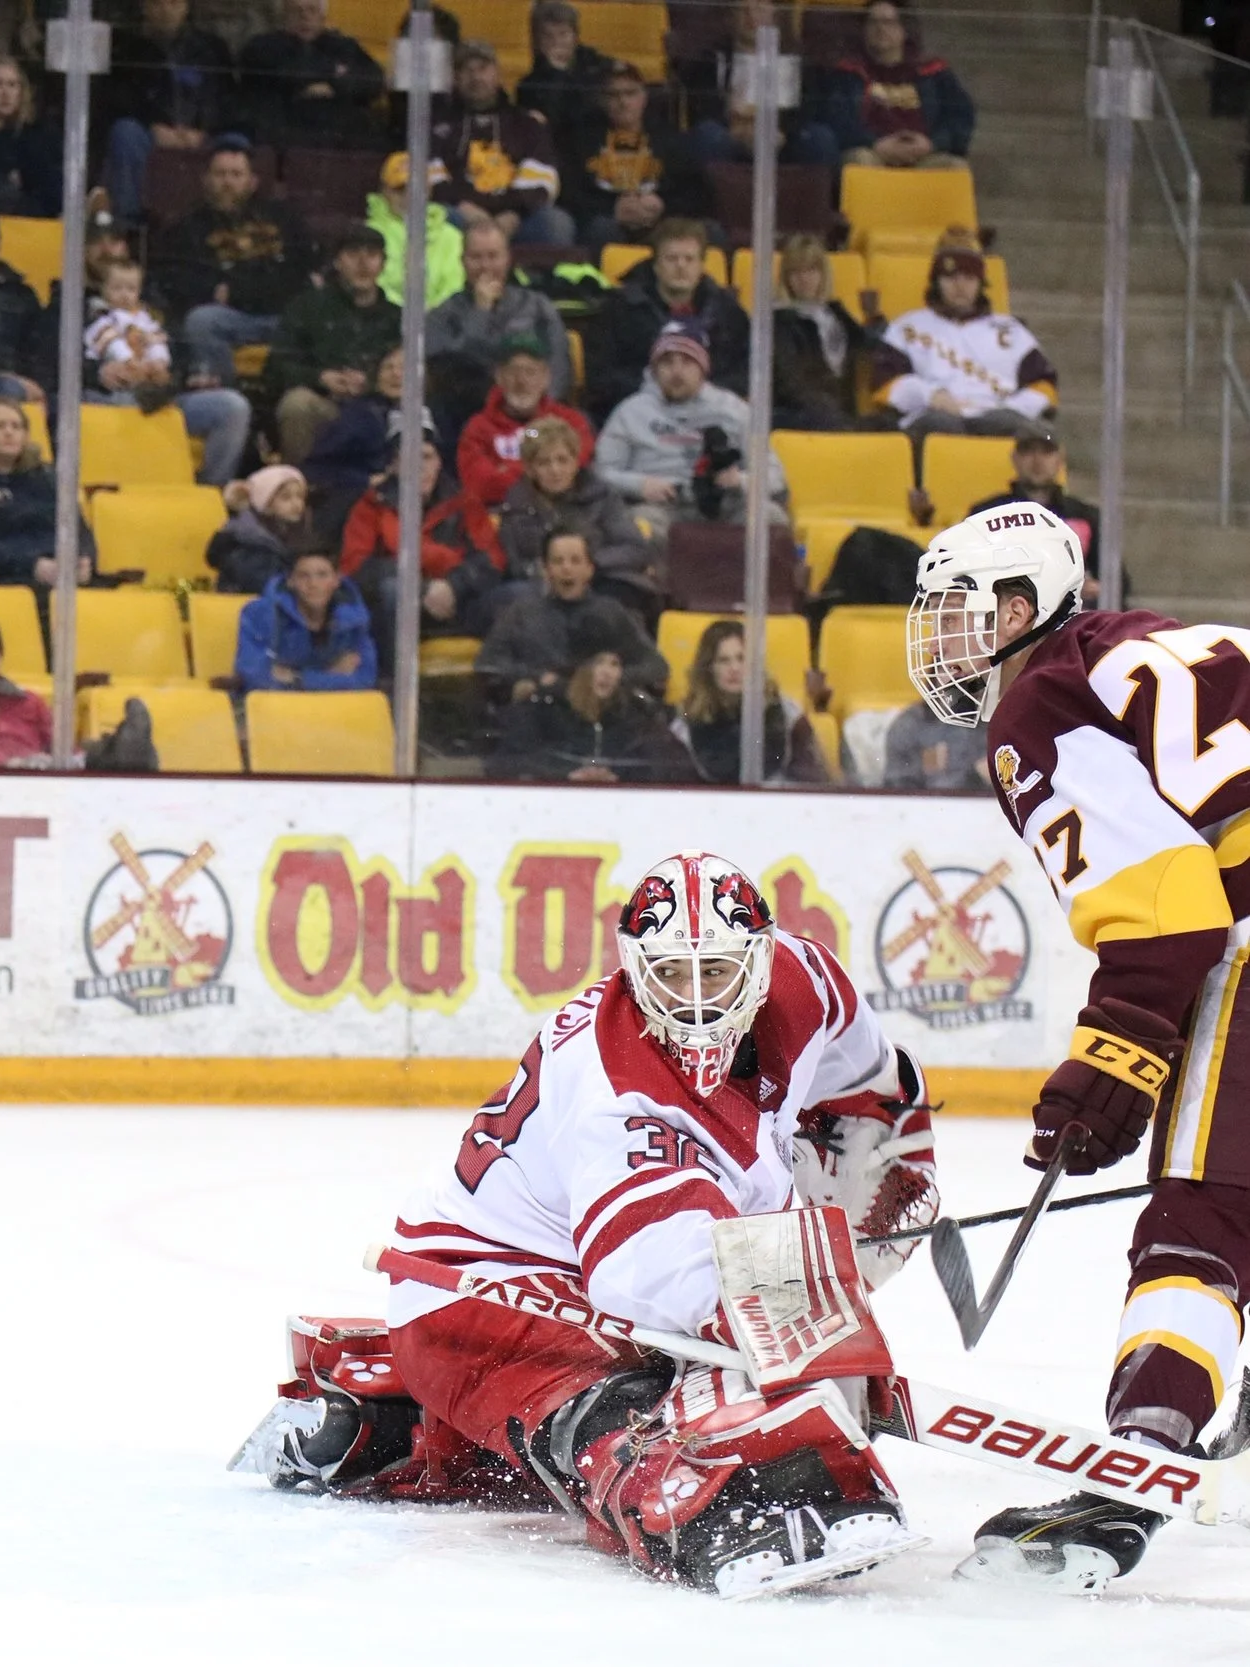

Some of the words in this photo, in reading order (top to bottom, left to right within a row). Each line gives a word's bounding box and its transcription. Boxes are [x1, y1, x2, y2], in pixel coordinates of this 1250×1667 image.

[986, 513, 1036, 532] UMD
[1034, 806, 1089, 900] 7
[264, 848, 467, 1000] Old
[731, 1294, 786, 1371] VAUGHN
